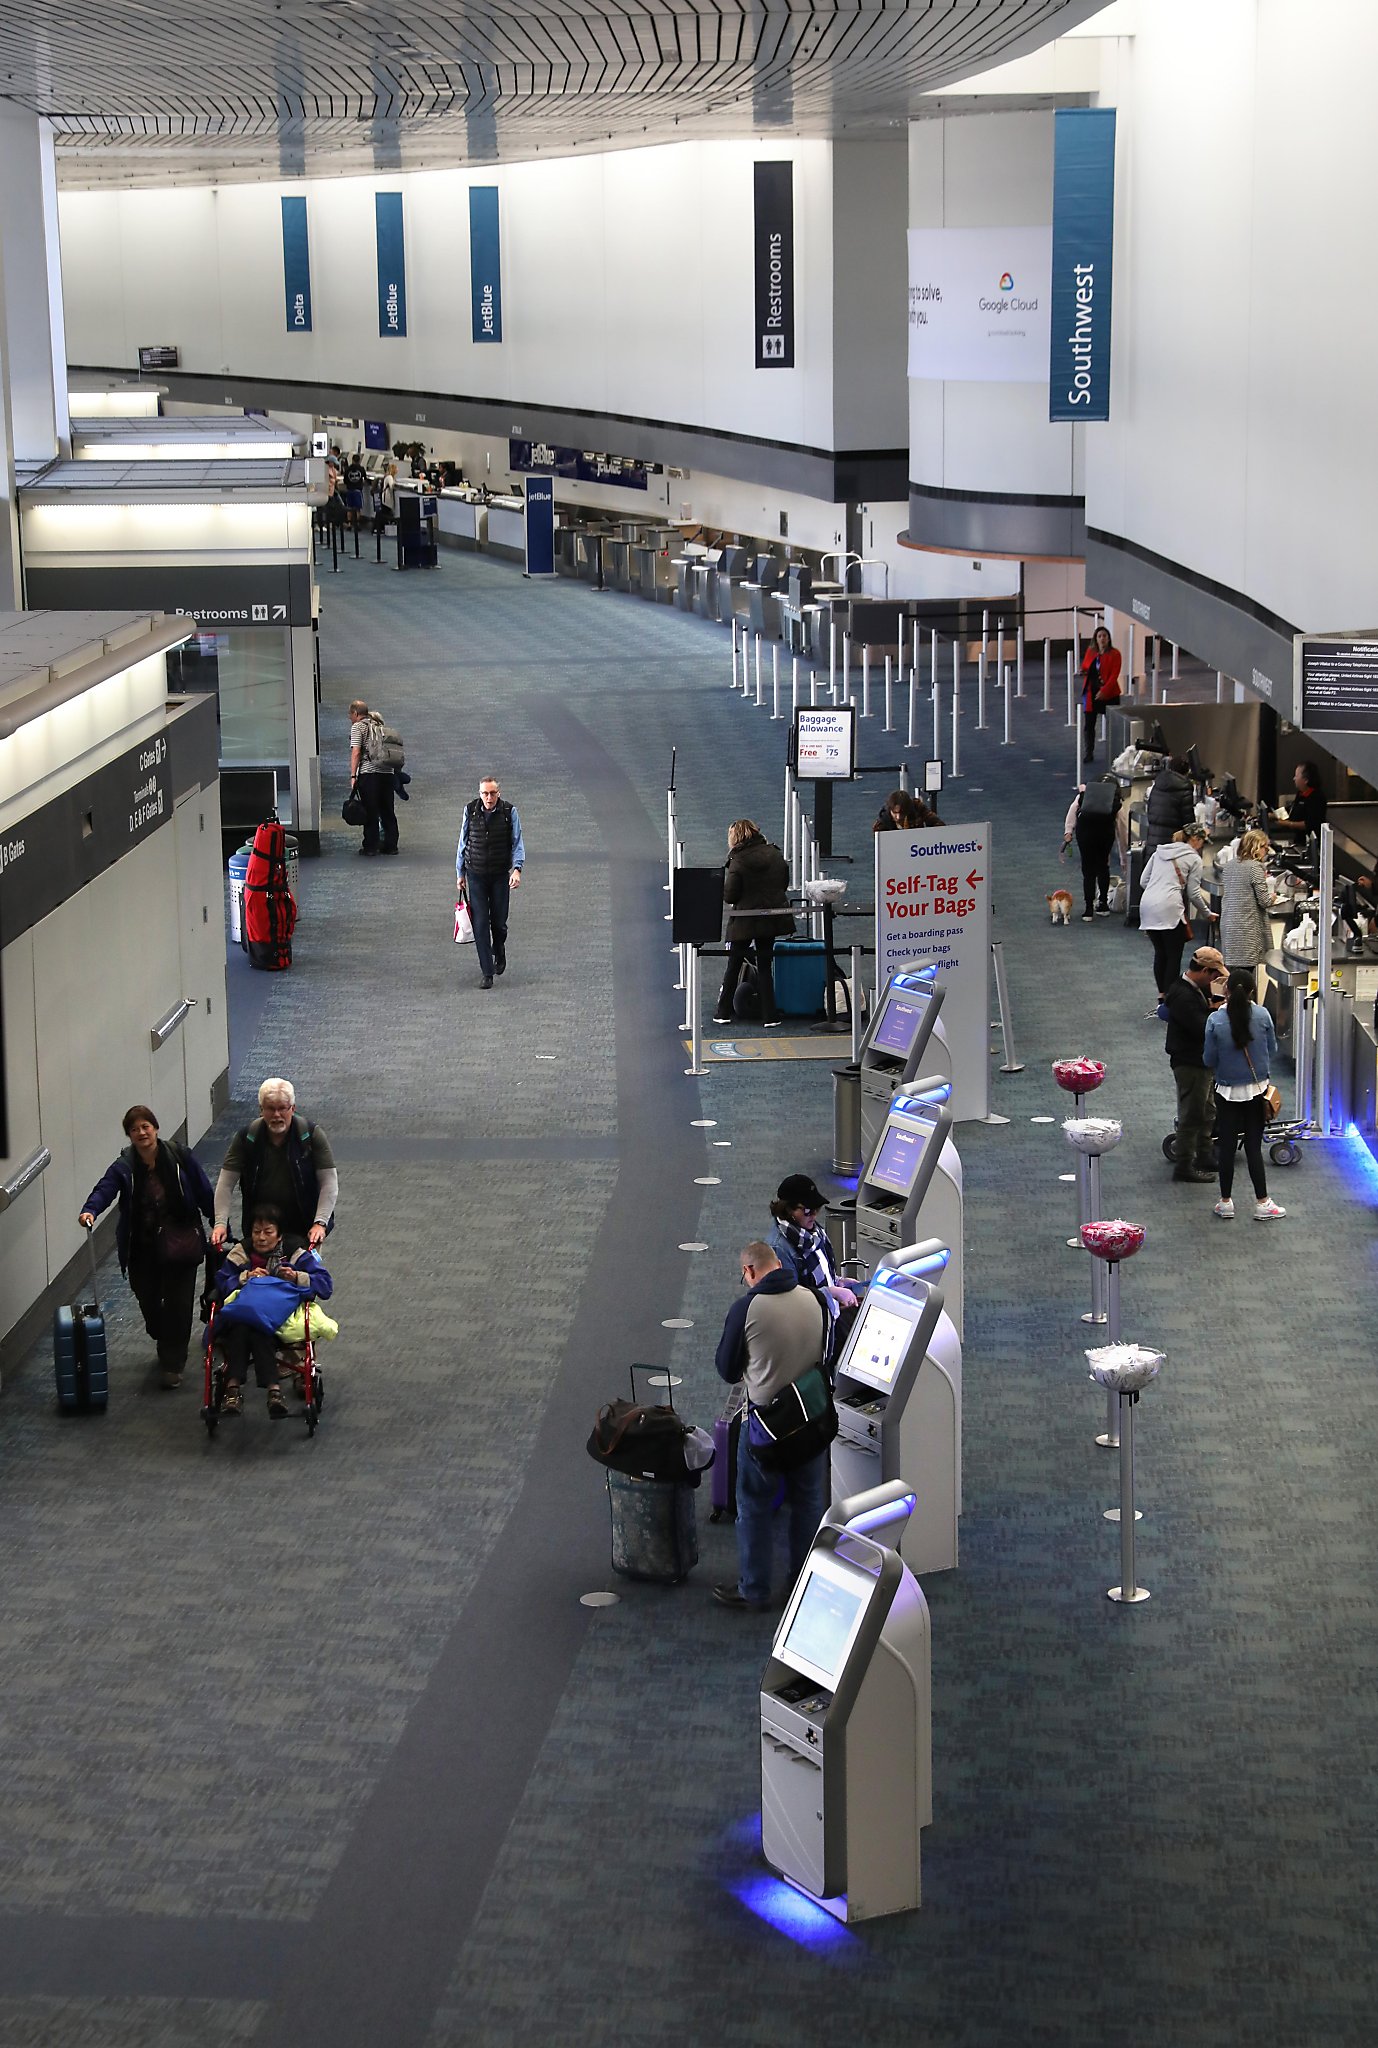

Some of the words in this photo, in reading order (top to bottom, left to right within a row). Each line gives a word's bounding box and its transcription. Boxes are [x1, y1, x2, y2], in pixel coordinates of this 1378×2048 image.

[767, 233, 782, 328] Restrooms
[922, 283, 943, 302] solve,
[294, 293, 305, 325] Delta
[387, 283, 399, 330] JetBlue
[482, 285, 494, 335] JetBlue
[979, 298, 1008, 314] Google
[1011, 298, 1038, 311] Cloud
[1068, 263, 1094, 405] Southwest
[530, 443, 555, 466] jetBlue
[528, 492, 551, 502] jetBlue
[800, 715, 837, 724] Baggage
[140, 754, 143, 771] C
[143, 750, 155, 769] Gates
[826, 748, 839, 756] $75
[135, 811, 138, 828] E
[146, 802, 157, 820] Gates
[4, 846, 8, 866] B
[9, 840, 25, 862] Gates
[910, 841, 976, 857] Southwest
[886, 875, 959, 895] Self-Tag
[886, 901, 929, 919] Your
[934, 897, 976, 917] Bags
[886, 932, 900, 941] Get
[908, 928, 945, 939] boarding
[947, 927, 964, 936] pass
[887, 948, 910, 957] Check
[912, 947, 931, 957] your
[932, 944, 951, 954] bags
[938, 959, 959, 970] flight
